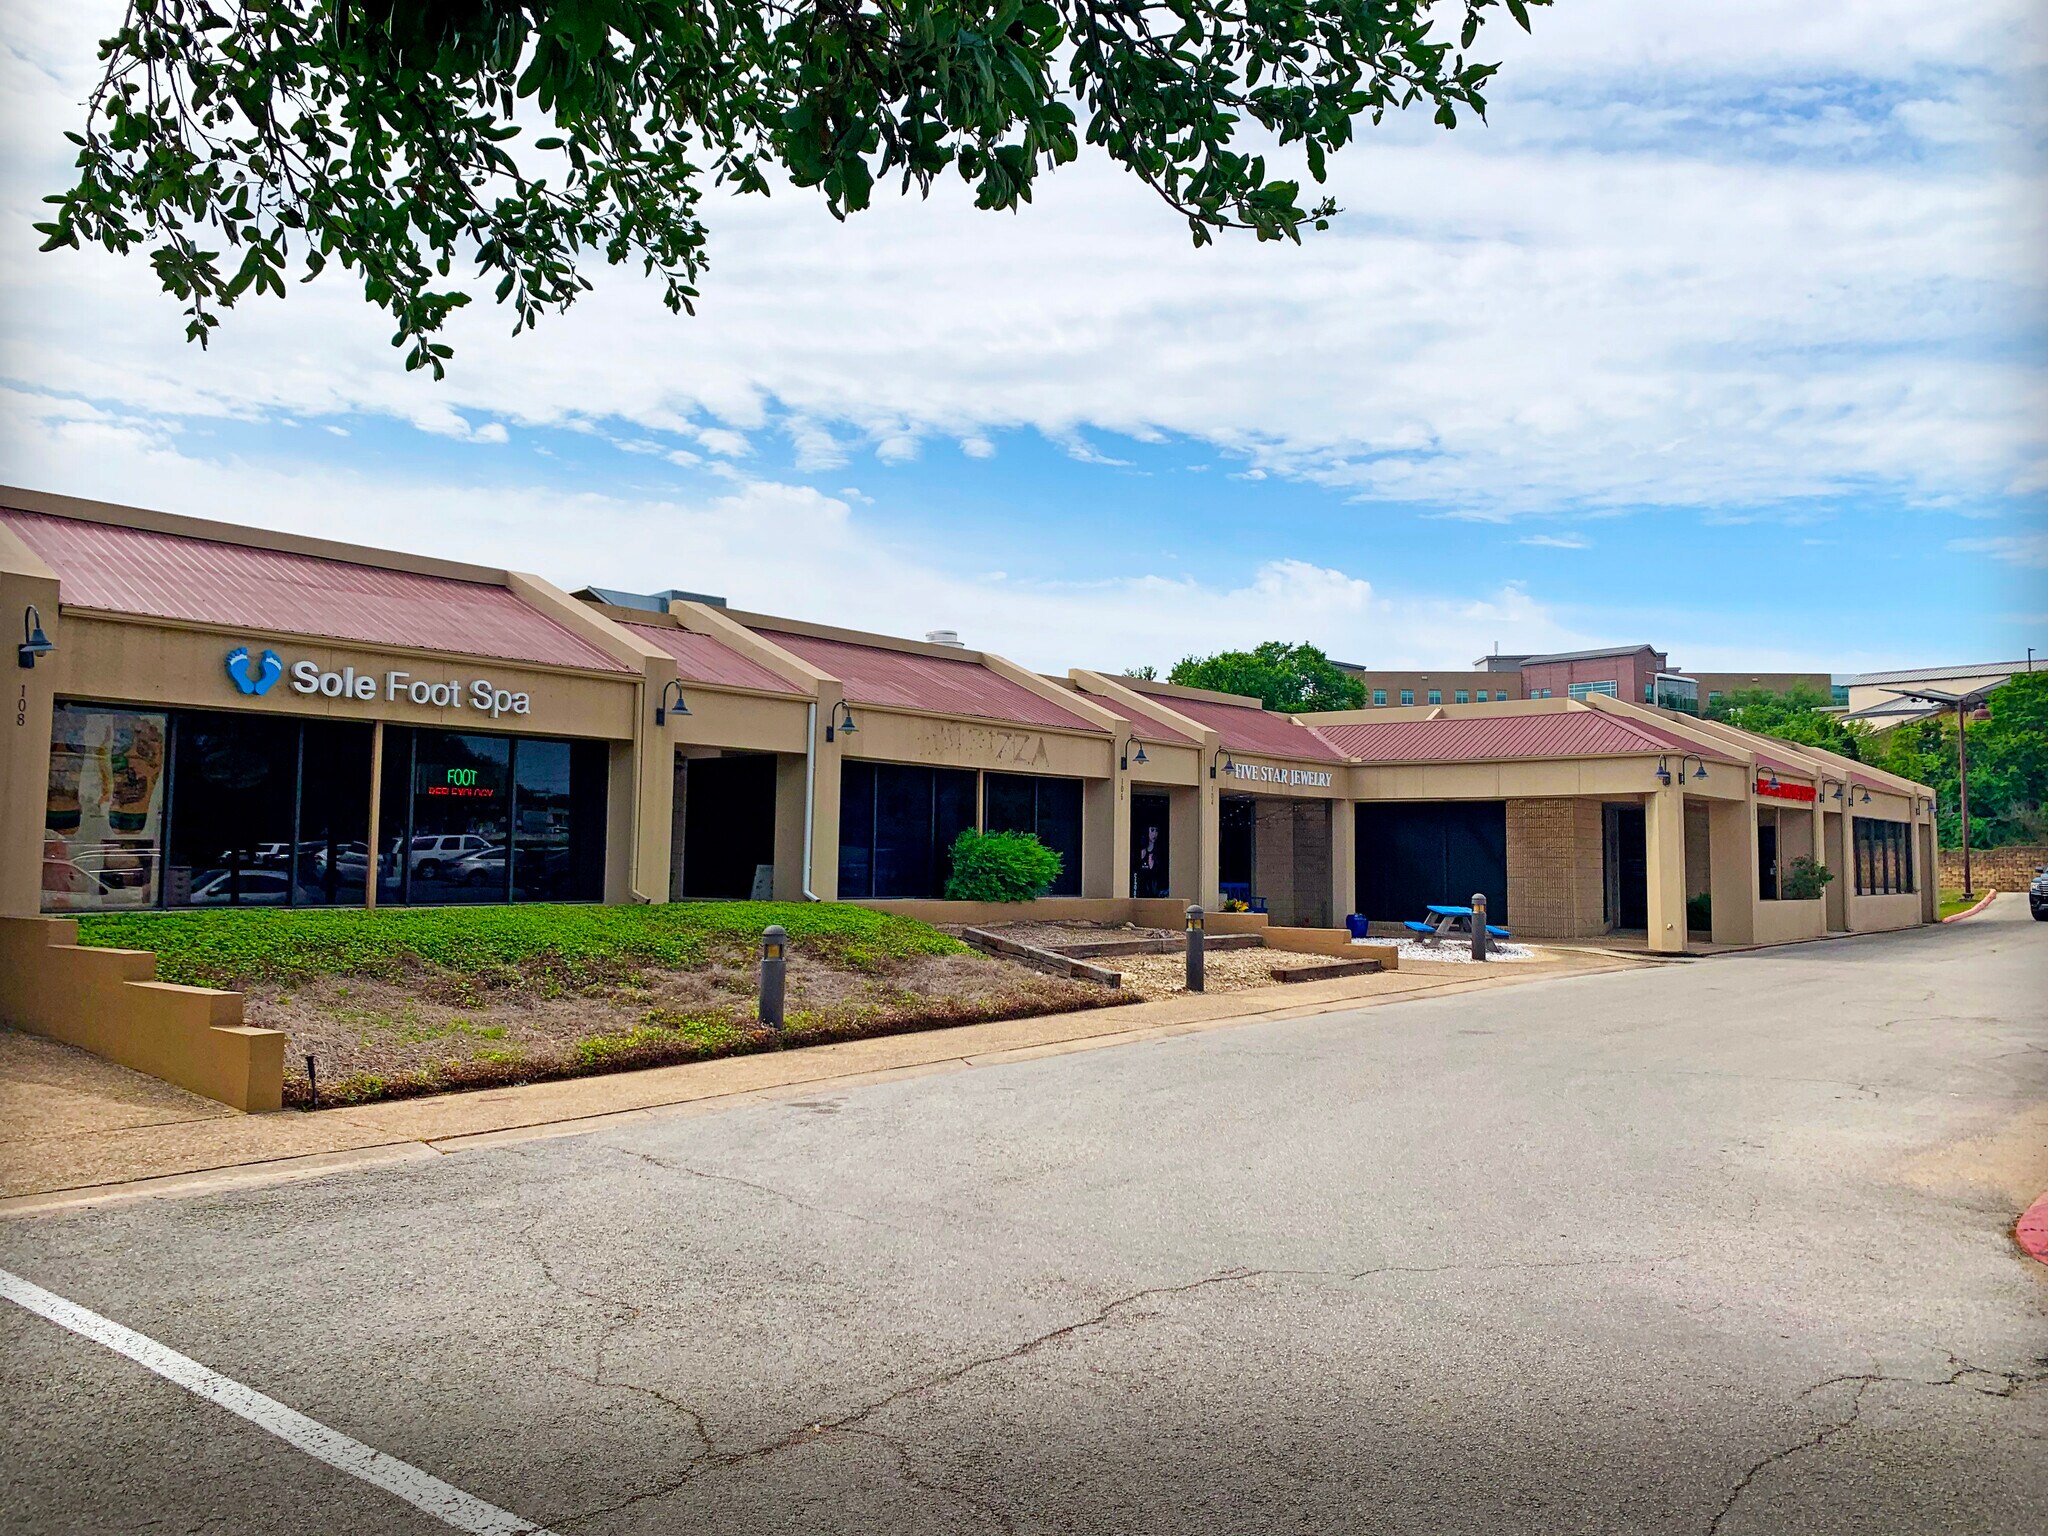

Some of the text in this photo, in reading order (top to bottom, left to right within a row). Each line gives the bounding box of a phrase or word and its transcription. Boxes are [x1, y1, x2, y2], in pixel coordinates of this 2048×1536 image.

[16, 684, 26, 727] 108
[290, 660, 531, 718] Sole Foot Spa
[447, 768, 478, 786] FOOT
[1234, 763, 1333, 787] FIVE STAR JEWELRY
